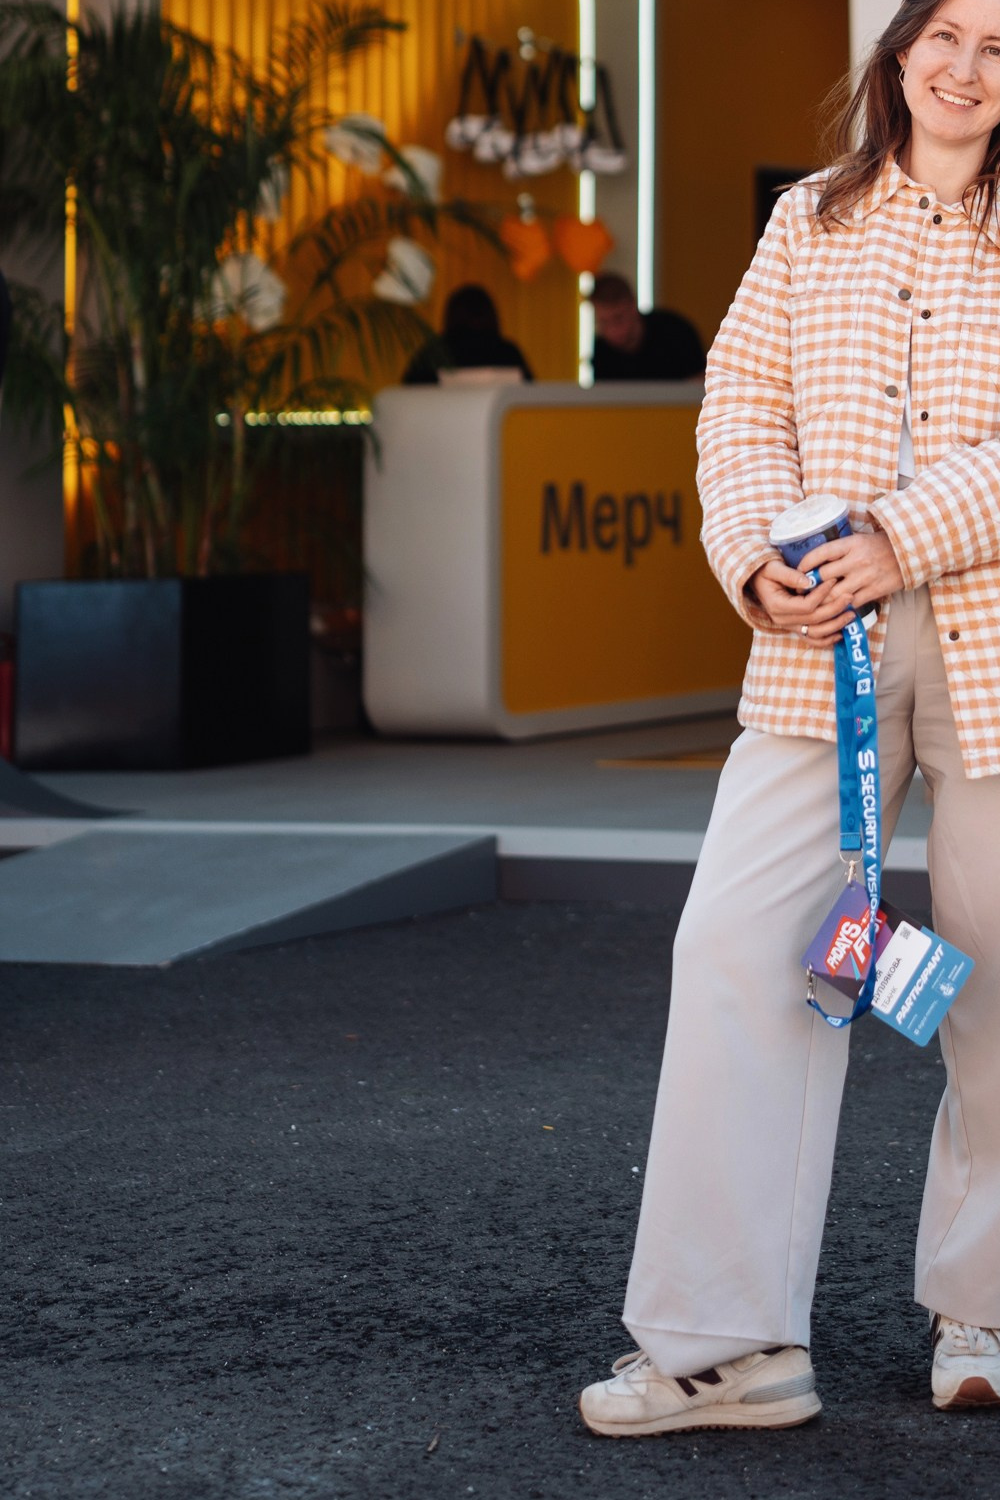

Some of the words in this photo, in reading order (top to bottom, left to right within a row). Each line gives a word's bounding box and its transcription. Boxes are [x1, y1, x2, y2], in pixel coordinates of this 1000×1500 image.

[540, 480, 683, 568] Мерч
[845, 621, 866, 662] phd
[861, 773, 879, 860] SECURITY
[826, 921, 862, 970] PHDAYS
[873, 957, 902, 1003] ДУПЛЯКОВА
[881, 987, 898, 1008] ТБАНК
[896, 943, 945, 1025] PARTICIPANT
